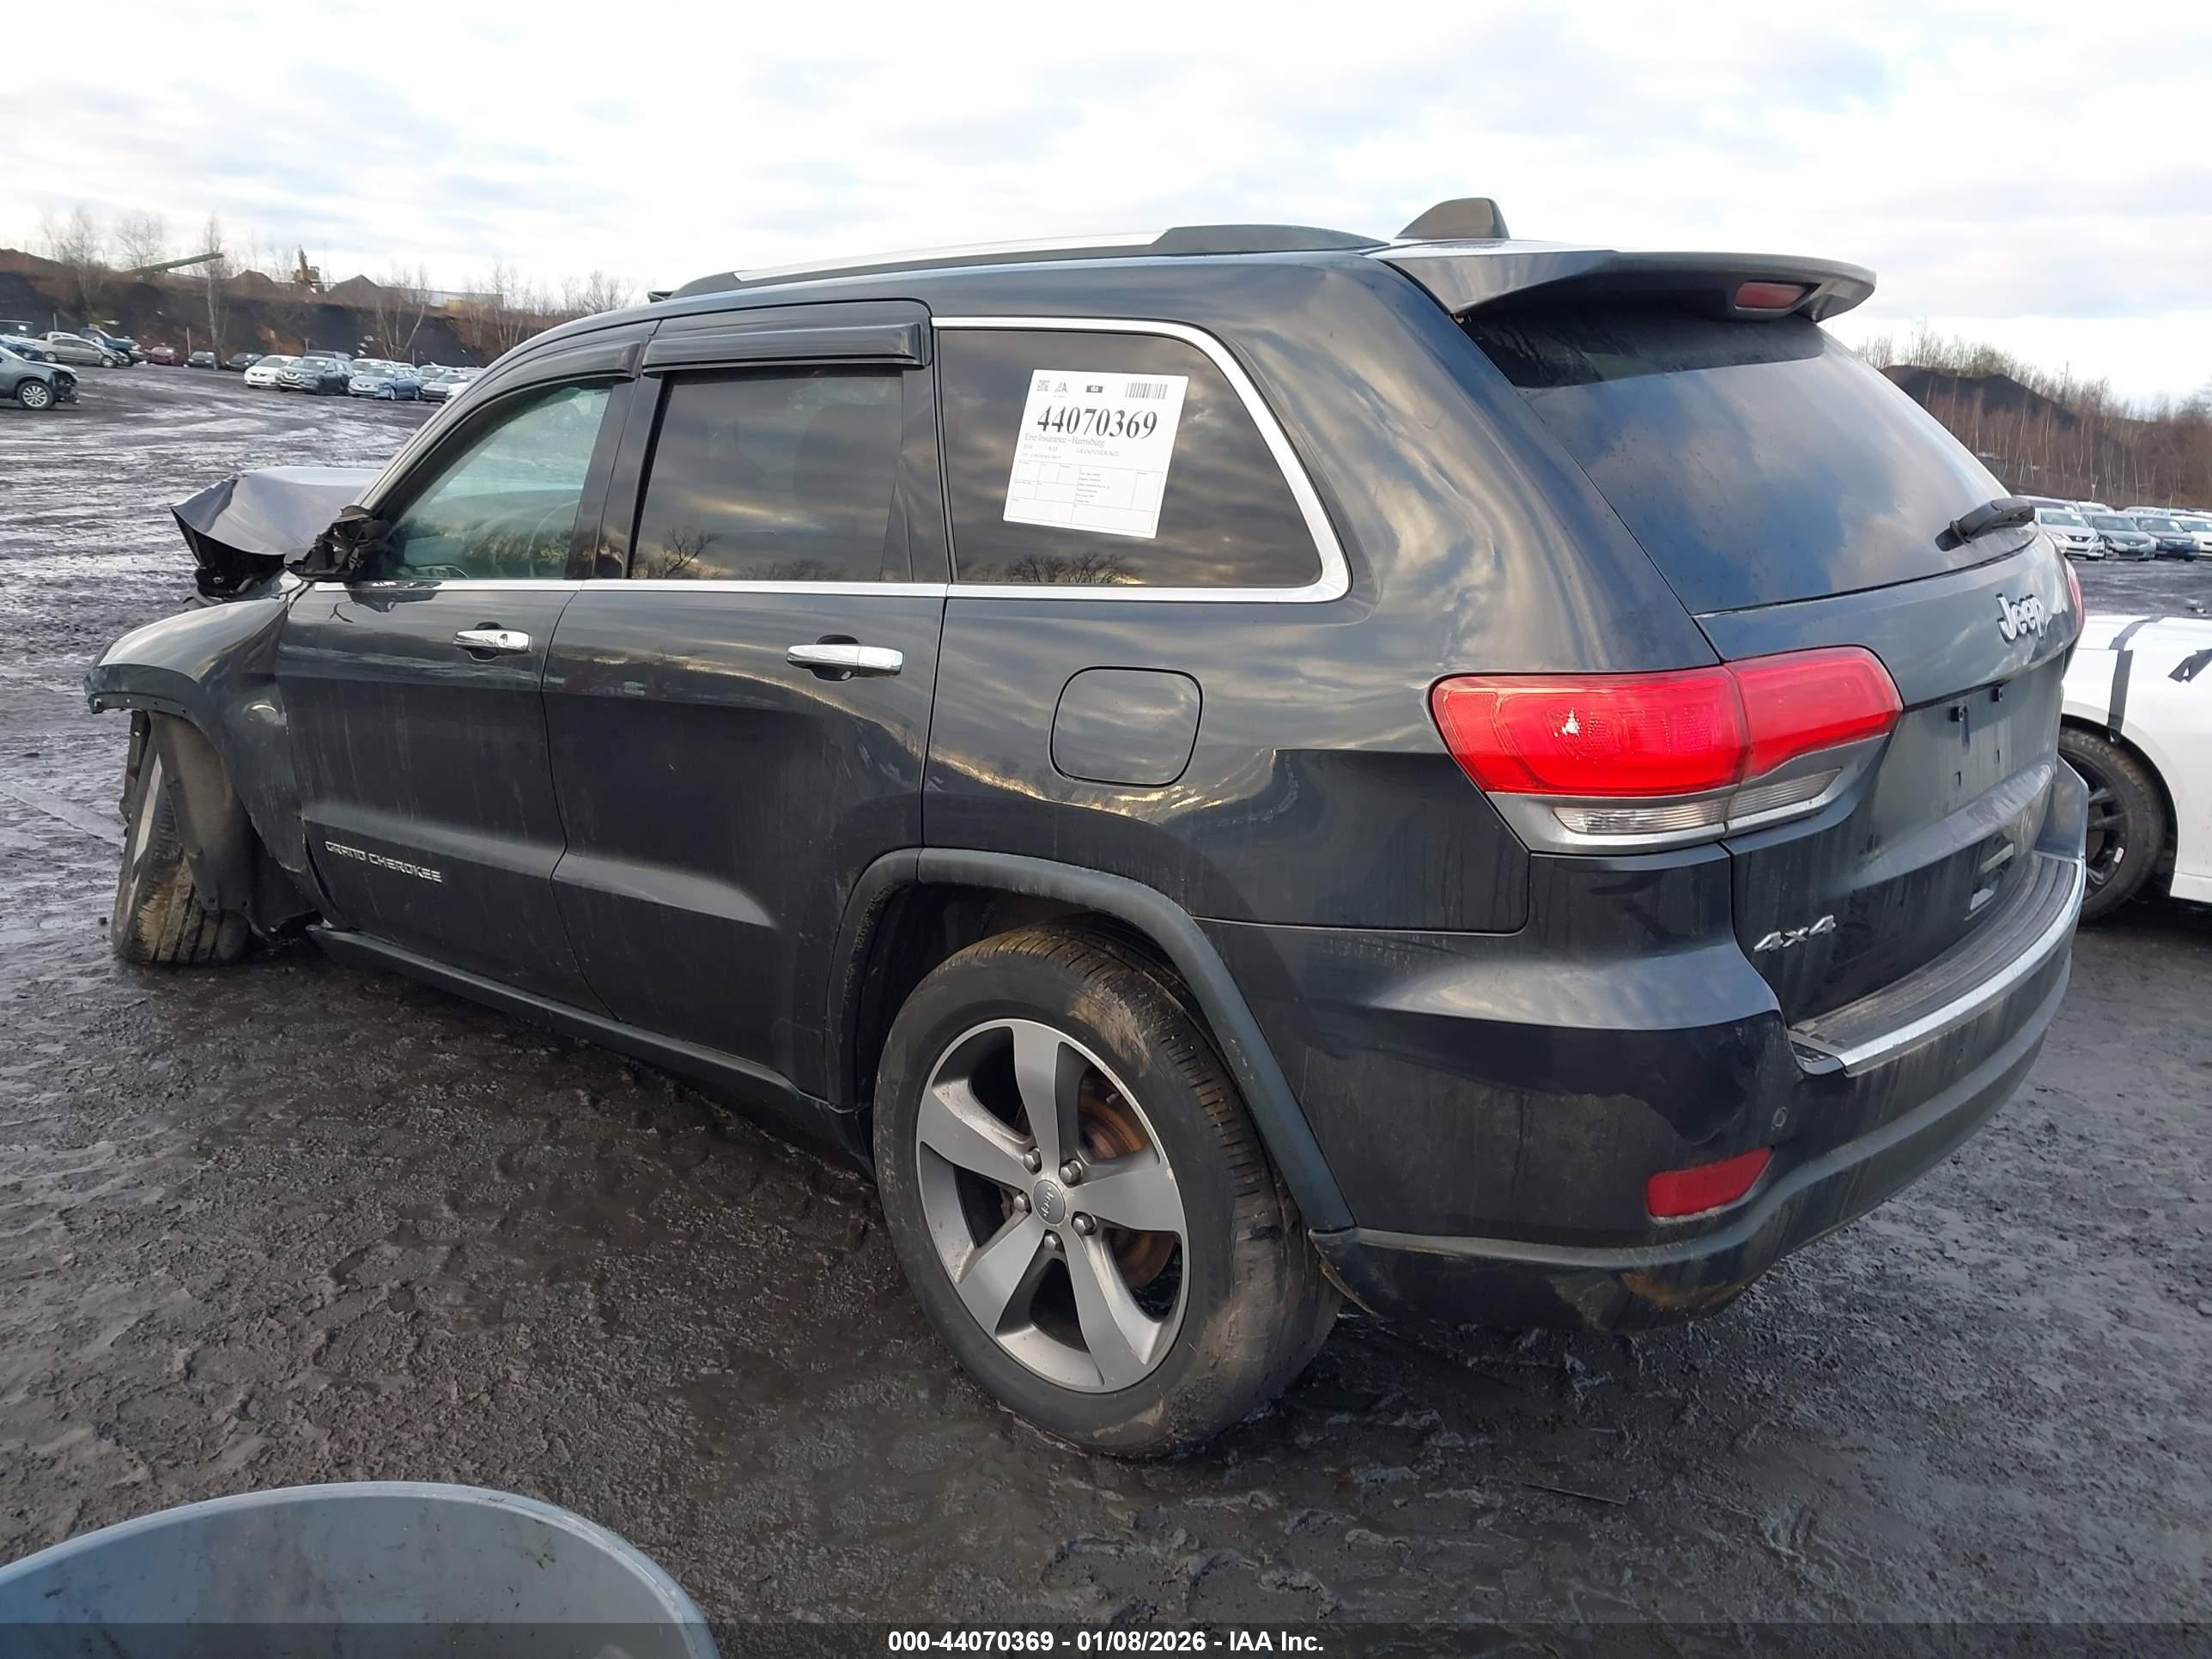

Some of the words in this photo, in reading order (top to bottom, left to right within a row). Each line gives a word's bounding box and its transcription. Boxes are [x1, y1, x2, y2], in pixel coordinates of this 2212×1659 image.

[1036, 405, 1158, 440] 44070369
[1996, 594, 2045, 641] Jeep
[325, 841, 367, 861] GRAND
[368, 853, 443, 883] CHEROKEE
[1040, 1187, 1055, 1218] Jeep
